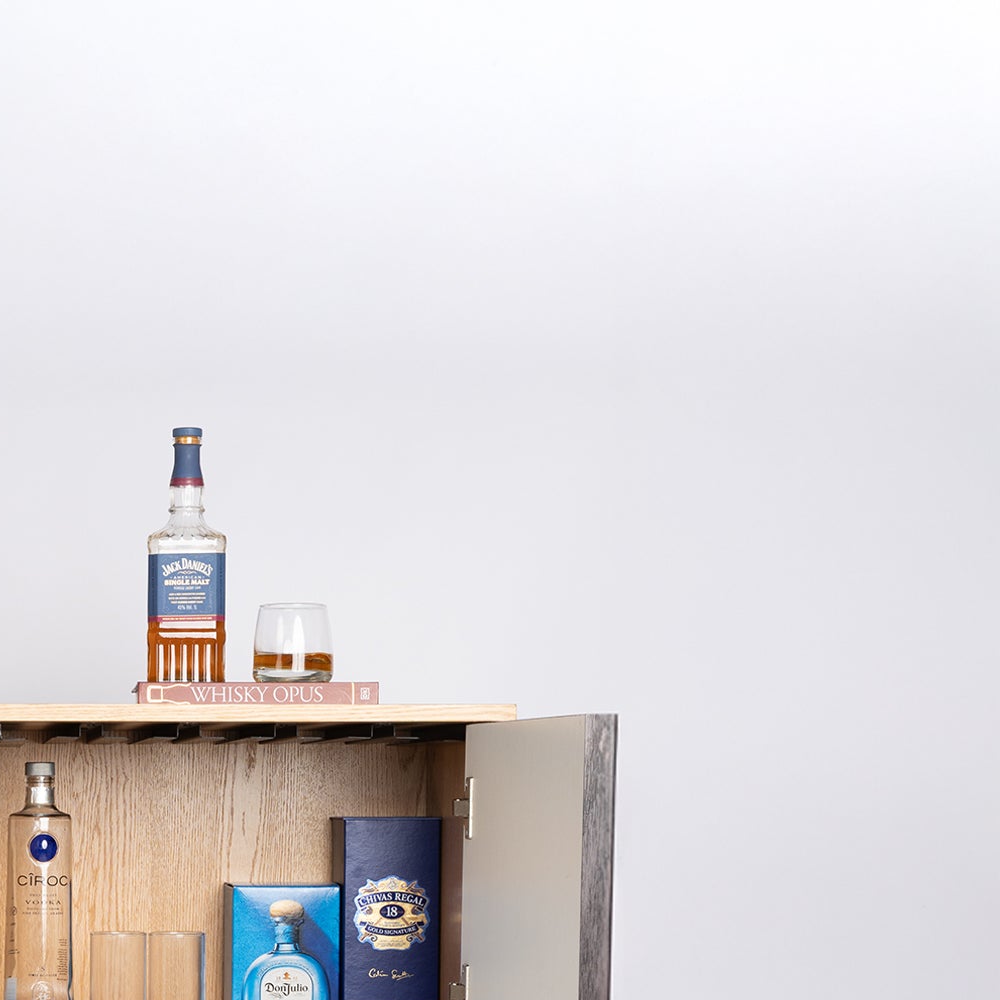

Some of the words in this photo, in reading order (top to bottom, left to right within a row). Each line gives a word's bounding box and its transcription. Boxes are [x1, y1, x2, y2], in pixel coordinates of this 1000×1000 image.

[161, 560, 182, 577] JACK
[181, 557, 213, 577] DANIEL'S
[190, 686, 269, 703] WHISKY
[272, 686, 324, 703] OPUS
[359, 892, 393, 906] CHIVAS
[394, 892, 424, 907] REGAL
[386, 906, 398, 917] 18
[367, 924, 384, 934] GOLD
[384, 924, 417, 935] SIGNATURE
